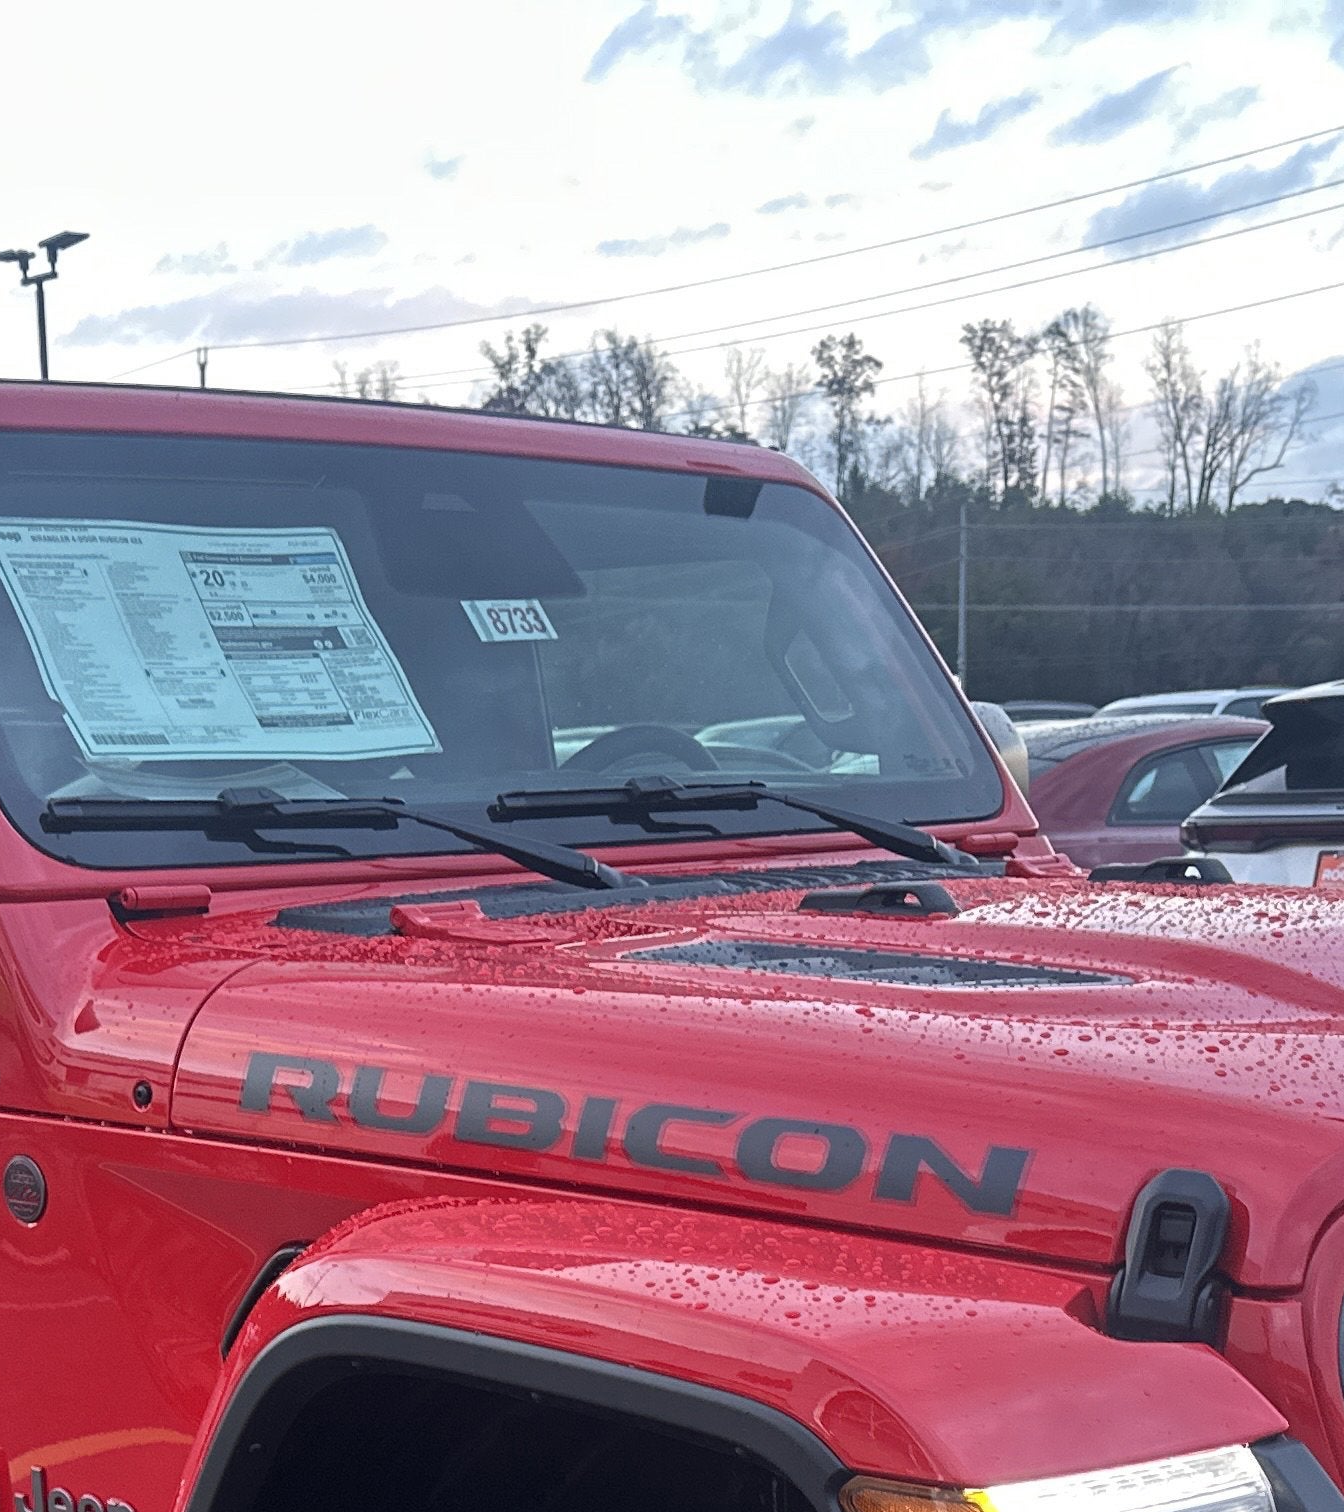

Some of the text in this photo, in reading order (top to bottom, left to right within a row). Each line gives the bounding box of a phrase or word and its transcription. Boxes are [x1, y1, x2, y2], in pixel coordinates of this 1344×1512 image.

[199, 569, 225, 587] 20
[486, 607, 547, 636] 8733
[238, 1050, 1033, 1217] RUBICON
